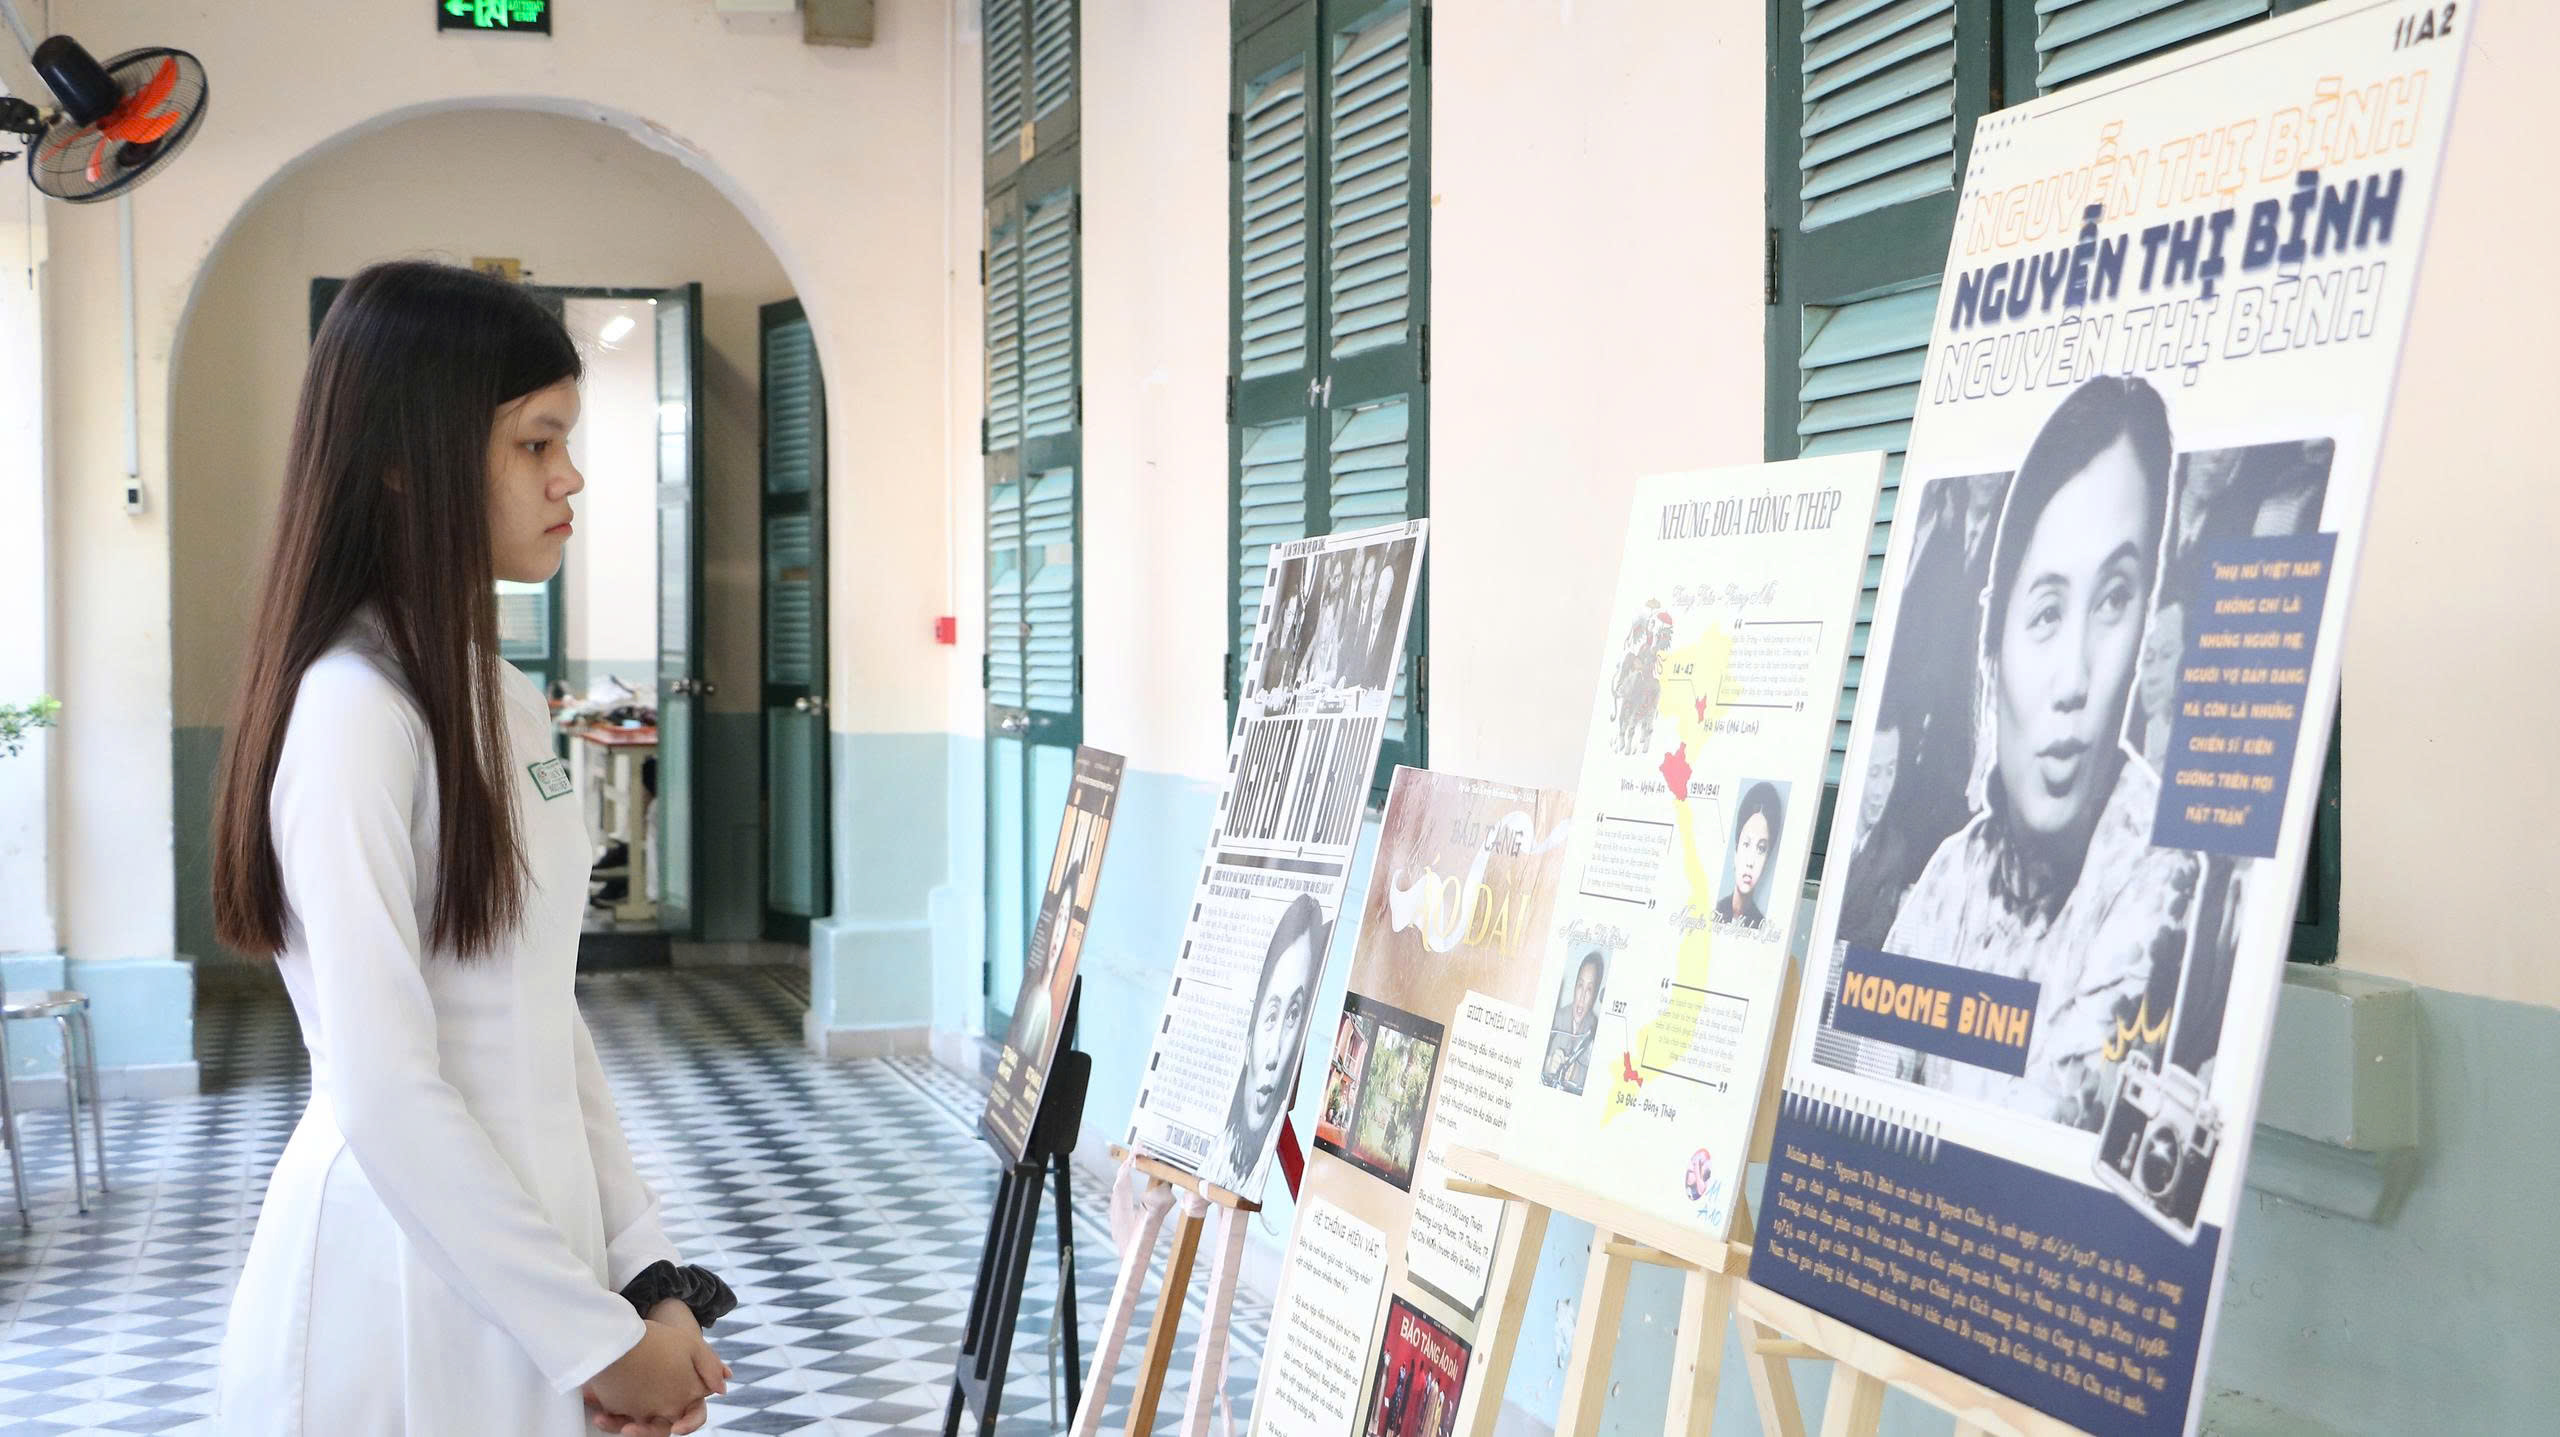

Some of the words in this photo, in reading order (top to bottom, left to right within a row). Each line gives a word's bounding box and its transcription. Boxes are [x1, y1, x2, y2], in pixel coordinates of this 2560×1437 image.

[2394, 2, 2457, 51] 11A2
[2157, 120, 2256, 206] THỊ
[2260, 69, 2428, 183] BÌNH
[1949, 204, 2129, 332] NGUYỄN
[2139, 208, 2236, 300] THỊ
[2241, 169, 2404, 270] BÌNH
[2123, 295, 2219, 387] THỊ
[2223, 262, 2386, 360] BÌNH
[1711, 497, 1744, 537] ĐÓA
[1744, 488, 1792, 535] HỒNG
[1795, 486, 1842, 531] THÉP
[1957, 991, 2030, 1049] BÌNH
